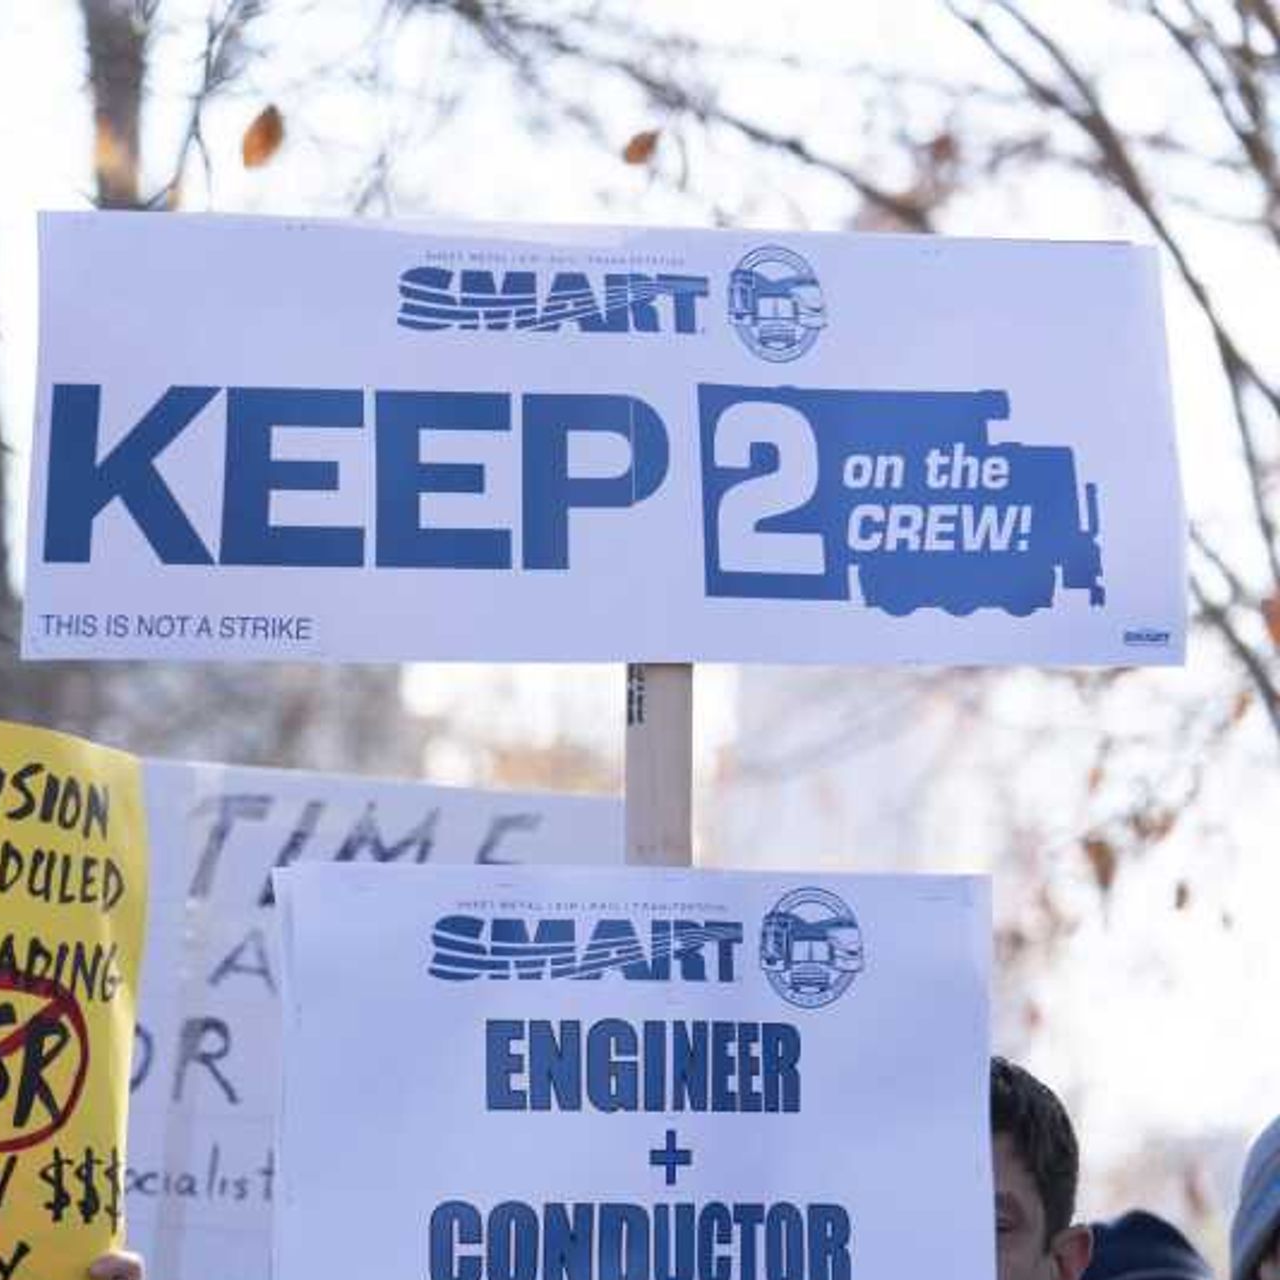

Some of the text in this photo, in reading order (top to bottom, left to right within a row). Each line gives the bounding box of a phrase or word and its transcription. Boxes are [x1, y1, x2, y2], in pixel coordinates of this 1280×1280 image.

[396, 266, 708, 335] SMART
[43, 382, 826, 576] KEEP 2
[842, 442, 1009, 490] on the
[847, 504, 1033, 554] CREW!
[41, 614, 312, 640] THIS IS NOT A STRIKE
[428, 915, 743, 982] SMART
[485, 1019, 801, 1113] ENGINEER
